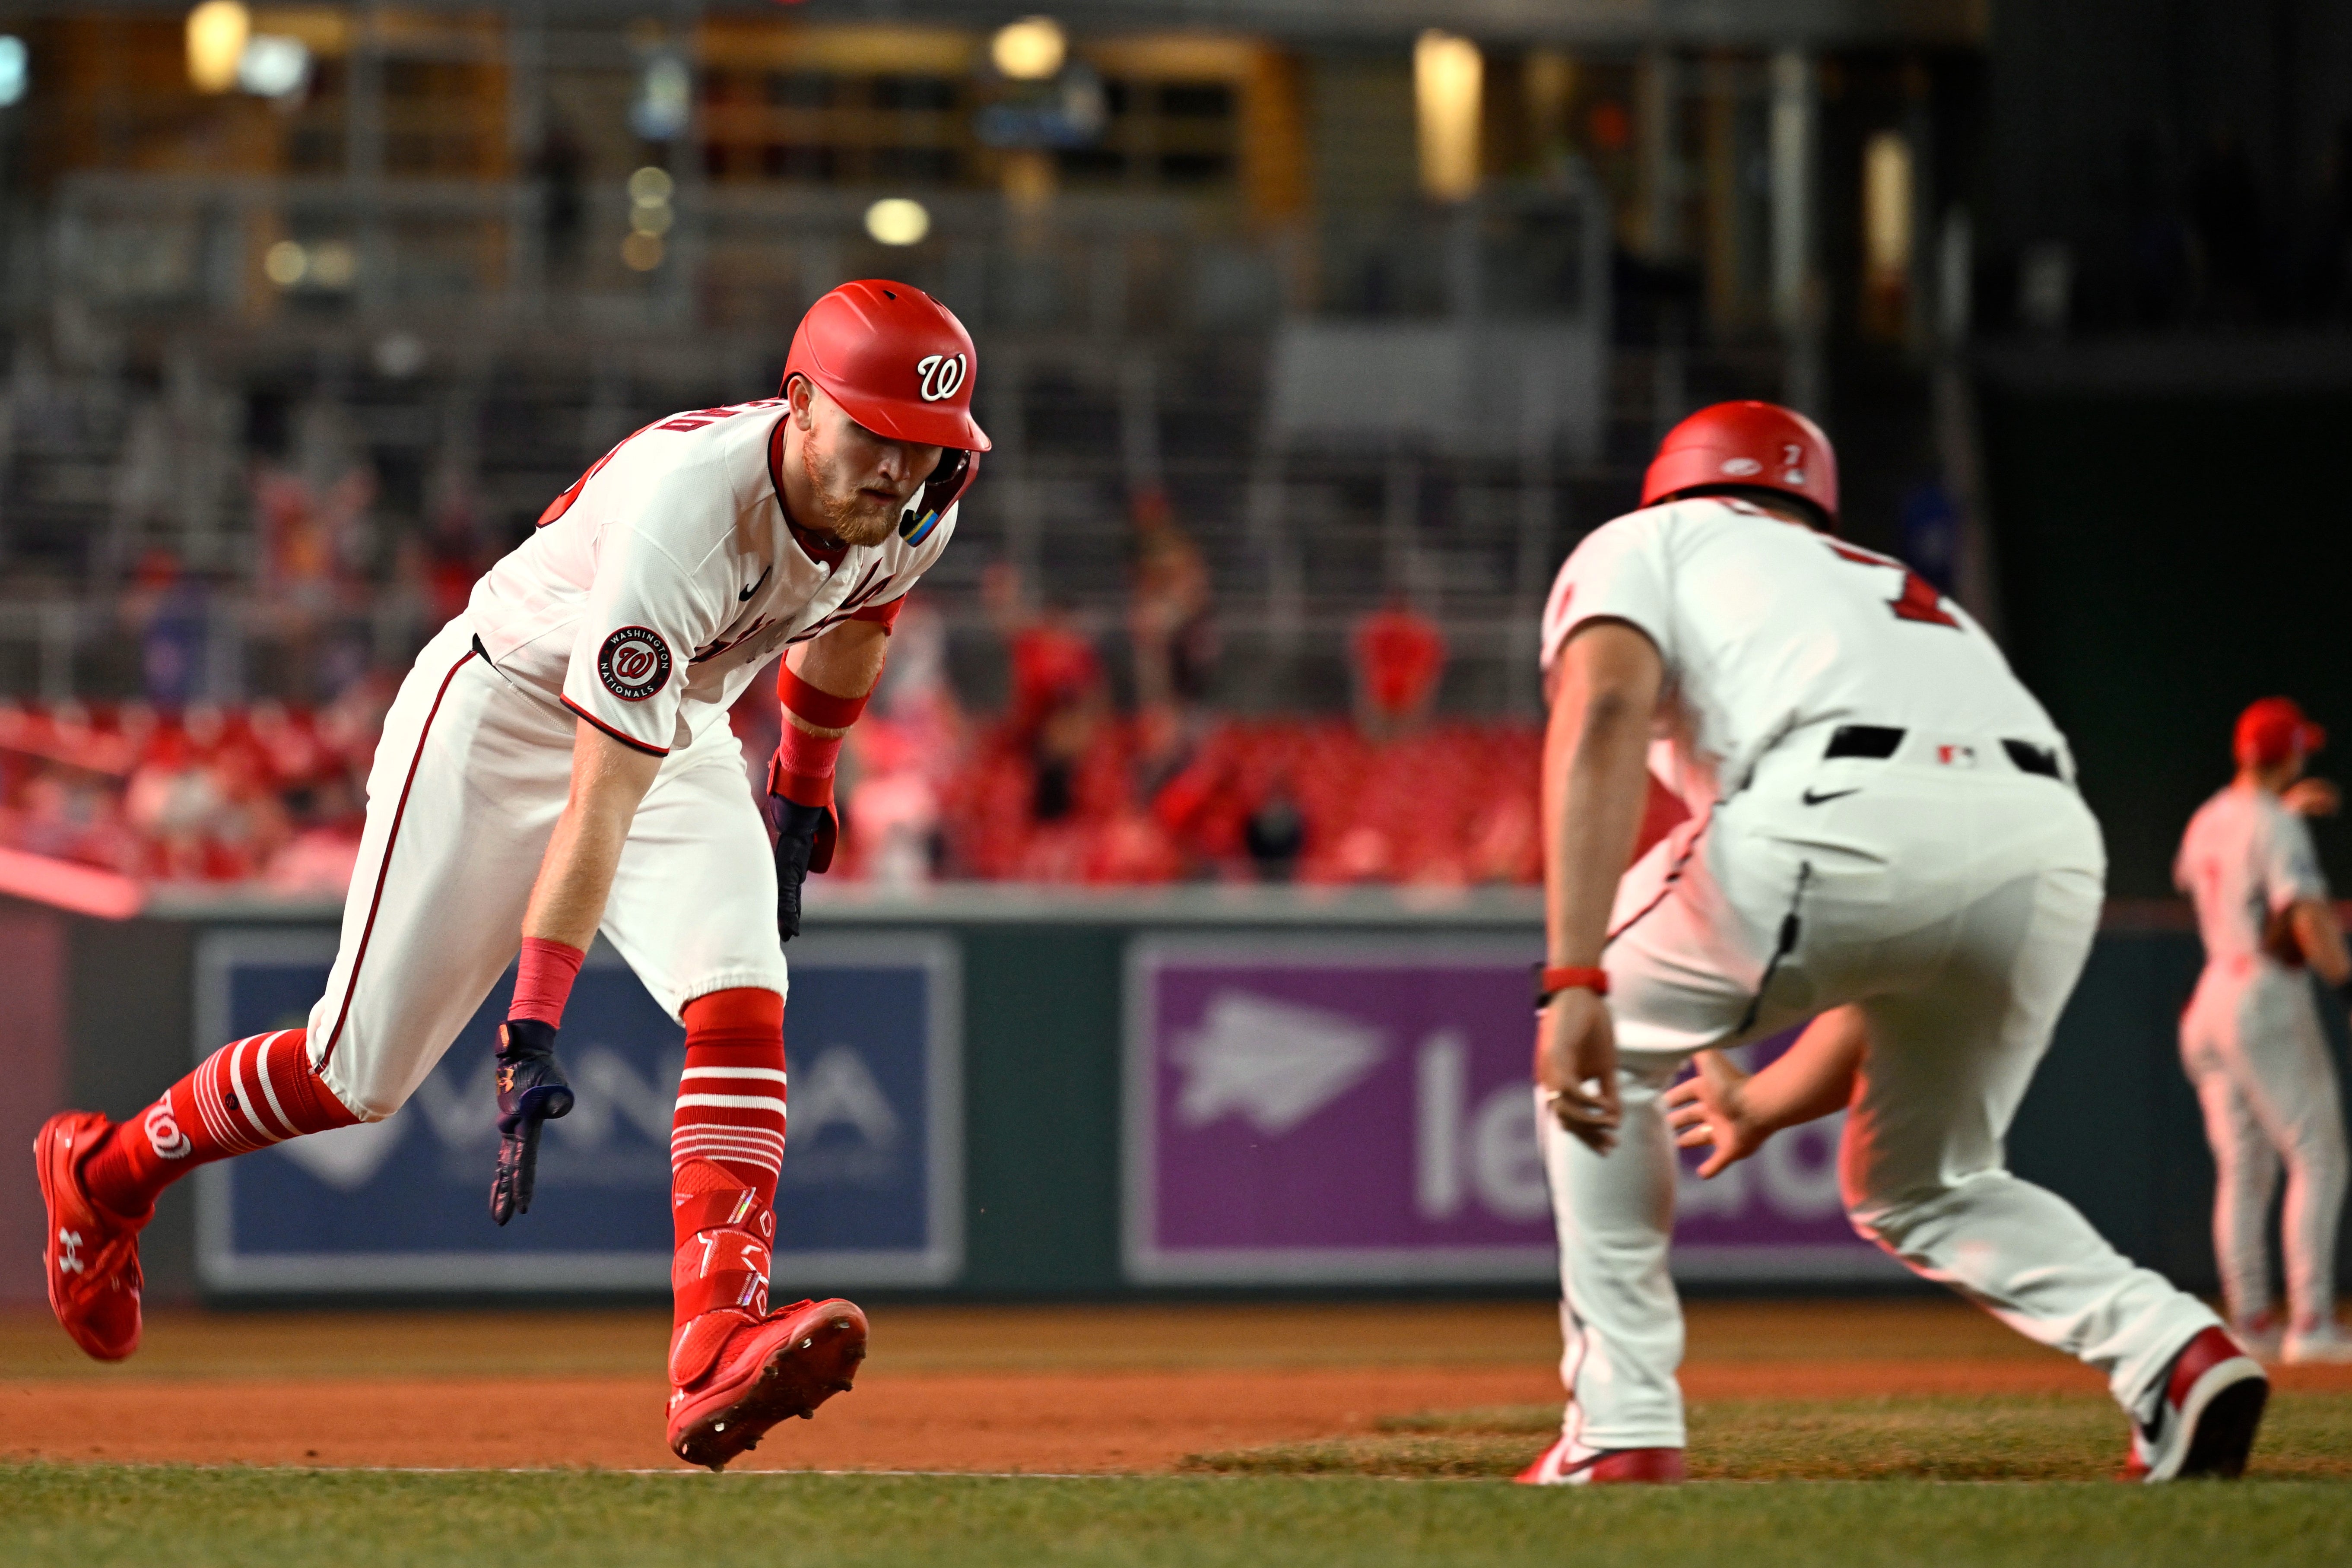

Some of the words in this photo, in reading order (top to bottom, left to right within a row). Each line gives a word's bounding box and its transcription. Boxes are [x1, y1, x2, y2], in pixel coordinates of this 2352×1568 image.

[917, 353, 967, 402] W
[610, 629, 669, 669] WASHINGTON
[617, 647, 654, 679] W
[600, 663, 654, 698] NATIONALS
